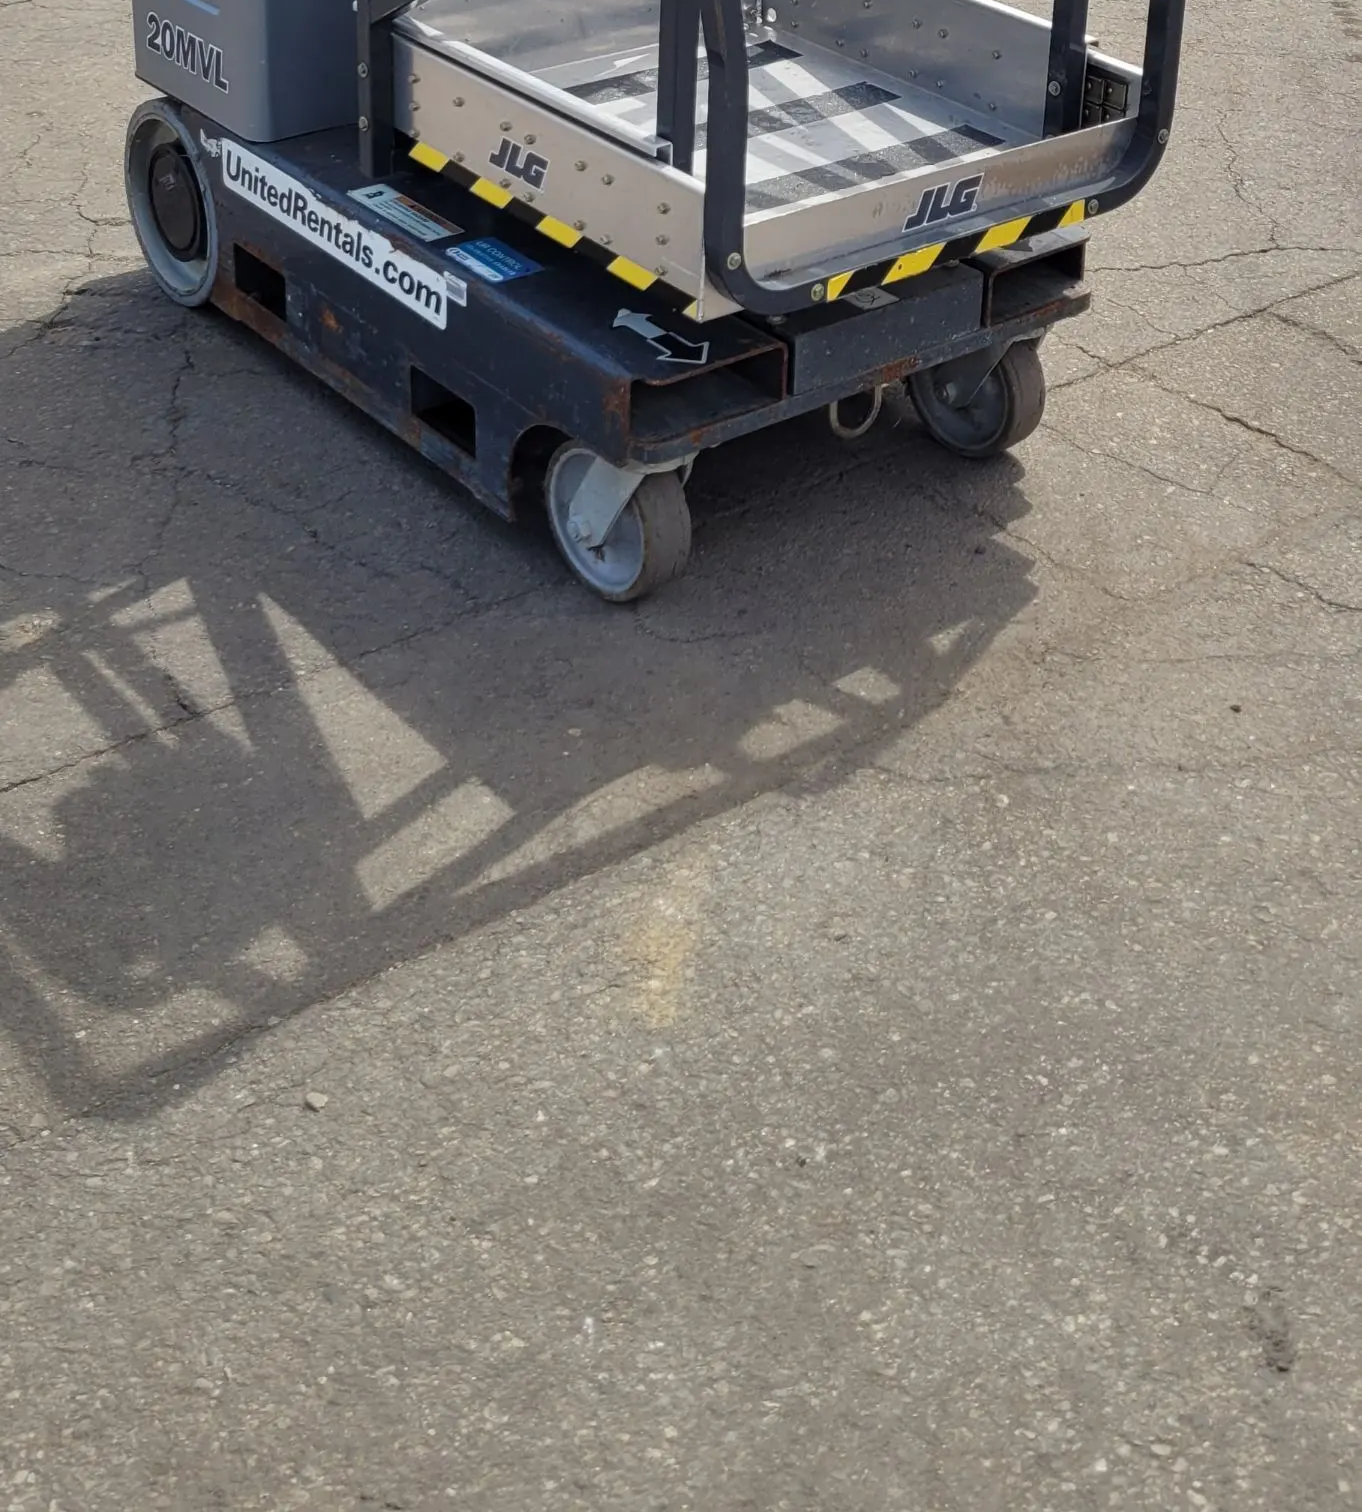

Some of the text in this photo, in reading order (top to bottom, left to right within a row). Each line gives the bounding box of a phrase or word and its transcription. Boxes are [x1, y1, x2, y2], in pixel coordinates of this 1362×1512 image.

[146, 11, 229, 94] 20MVL
[488, 135, 551, 193] JLG
[226, 150, 443, 315] UnitedRentals.com
[902, 173, 984, 232] JLG
